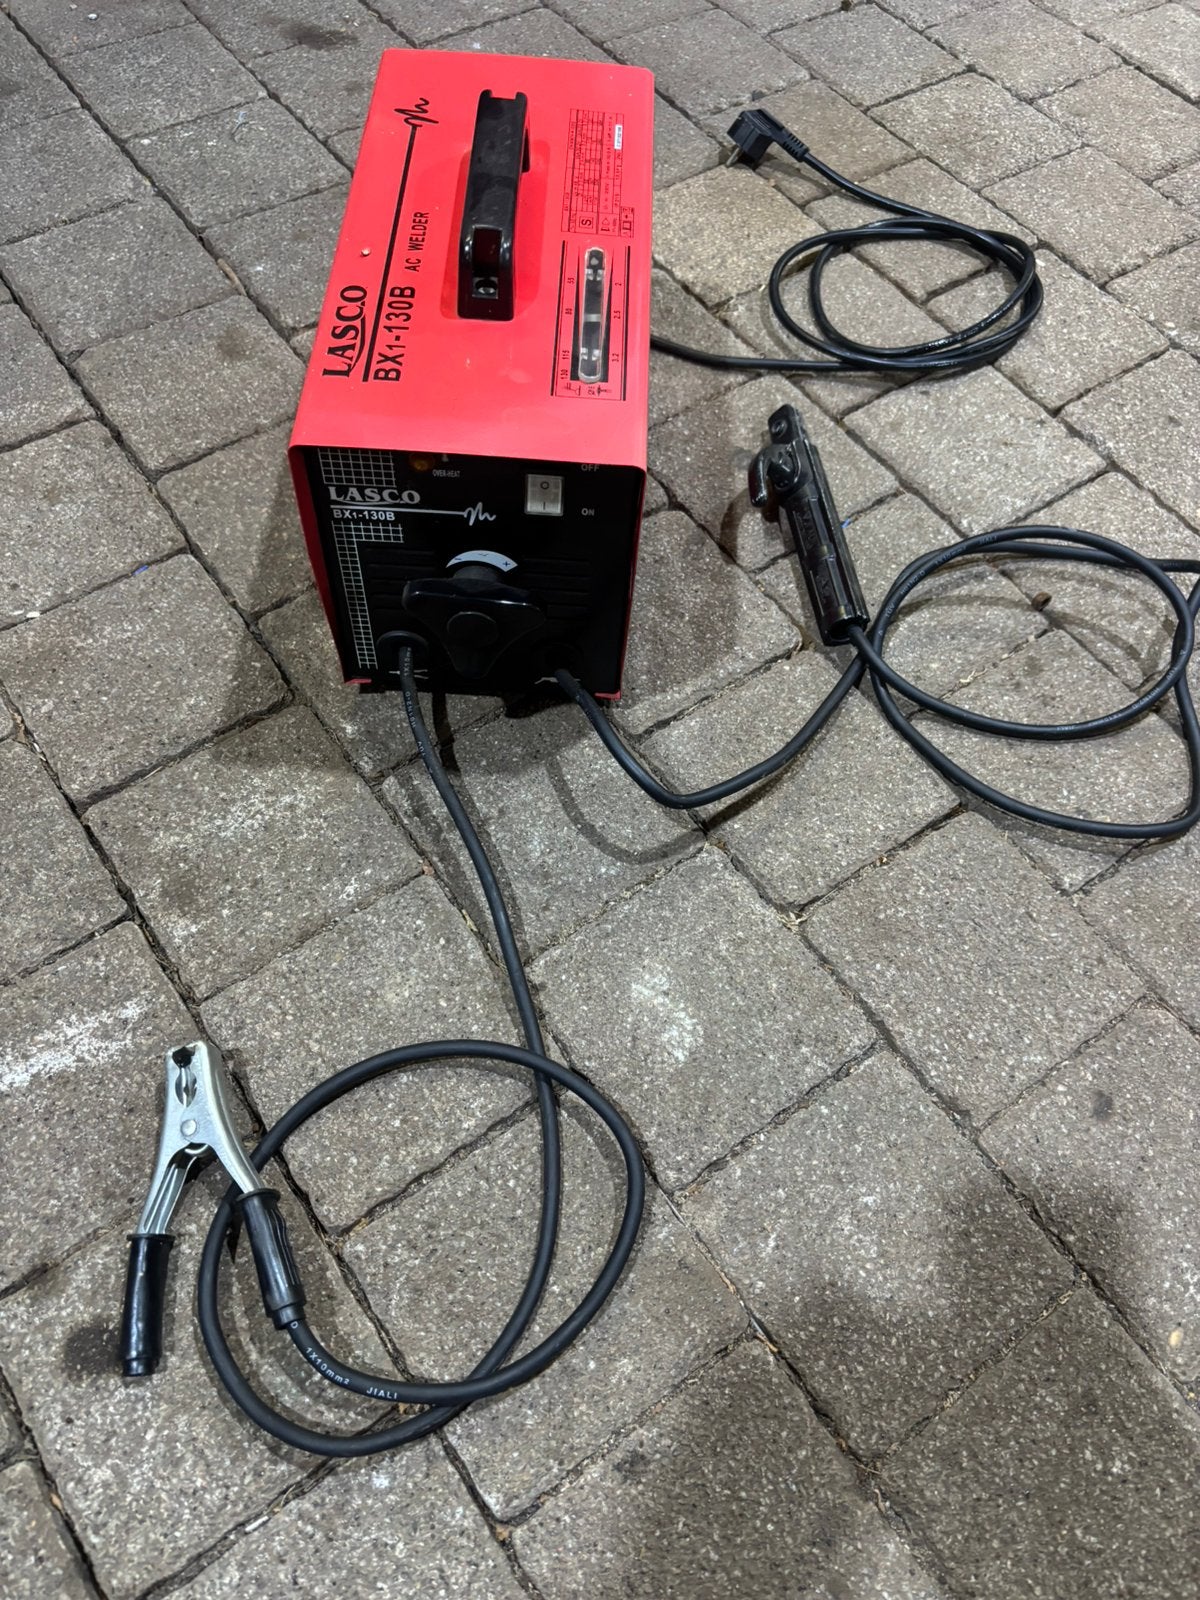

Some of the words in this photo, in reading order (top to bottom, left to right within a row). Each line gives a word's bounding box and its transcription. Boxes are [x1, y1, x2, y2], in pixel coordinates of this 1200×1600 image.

[408, 211, 430, 251] WELDER
[405, 257, 421, 273] AC
[613, 310, 621, 320] 2.5
[322, 285, 367, 378] LASCO
[561, 349, 570, 360] 115
[611, 353, 620, 363] 3.2
[560, 369, 569, 381] 130
[432, 469, 461, 478] OVER-HEAT
[581, 464, 600, 472] OFF
[328, 486, 421, 505] LASCO
[581, 508, 595, 516] ON
[366, 1386, 398, 1400] JIALI
